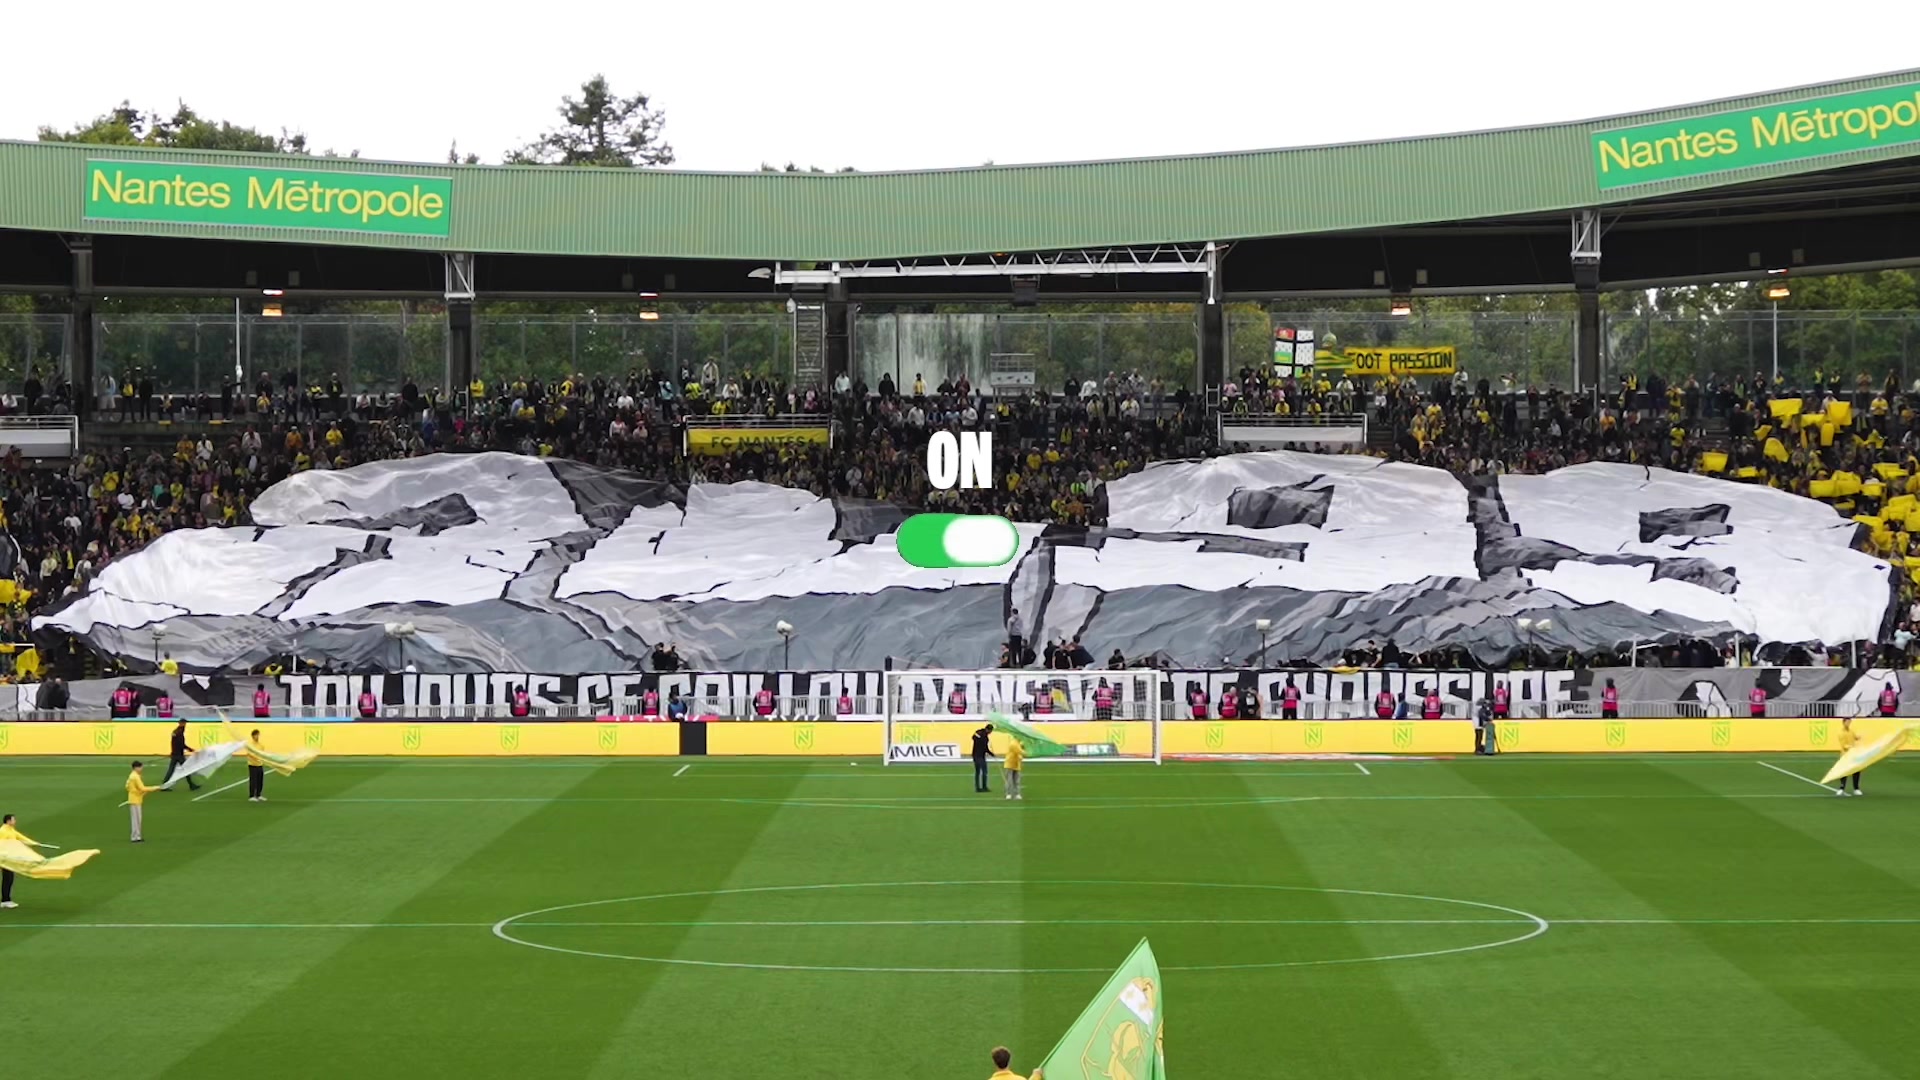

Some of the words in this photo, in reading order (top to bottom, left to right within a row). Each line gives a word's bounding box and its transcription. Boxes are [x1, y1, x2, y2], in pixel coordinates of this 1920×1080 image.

[1598, 128, 1739, 173] Nantes
[91, 168, 232, 209] Nantes
[1389, 350, 1453, 370] PASSION
[711, 436, 733, 449] FC
[738, 435, 806, 449] NANTES
[280, 672, 562, 718] TOUJOURS
[1257, 670, 1575, 719] CHAUSSURE
[892, 744, 958, 758] MILLET
